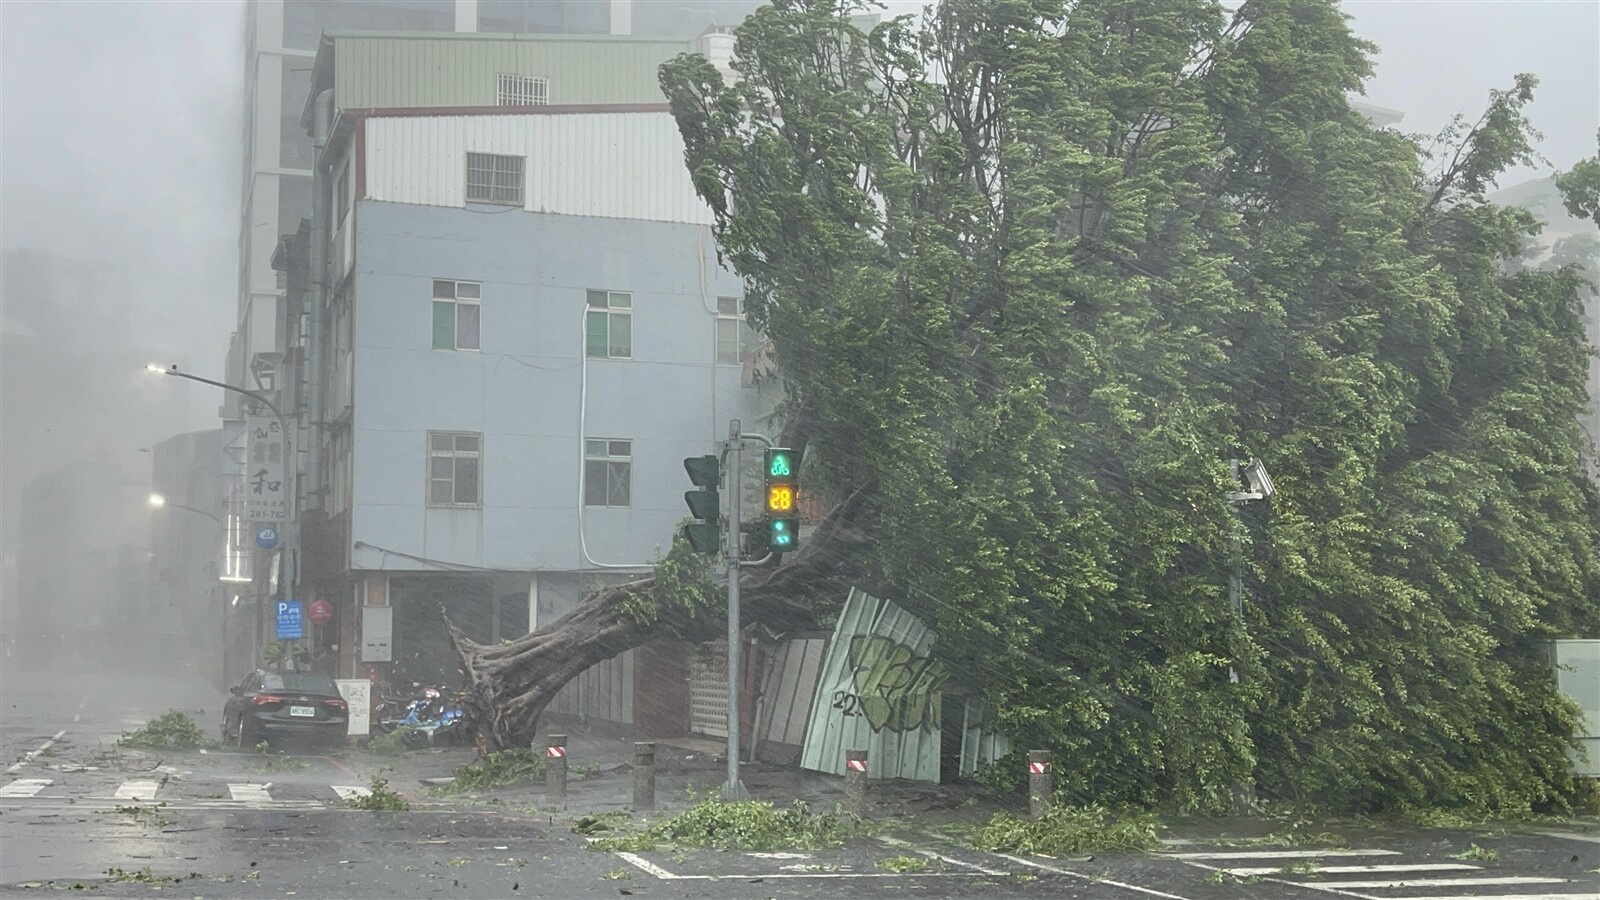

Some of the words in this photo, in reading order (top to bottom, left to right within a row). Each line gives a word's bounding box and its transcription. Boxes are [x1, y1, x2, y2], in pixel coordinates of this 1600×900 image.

[250, 468, 281, 495] 和
[769, 487, 792, 510] 28
[279, 602, 287, 615] P
